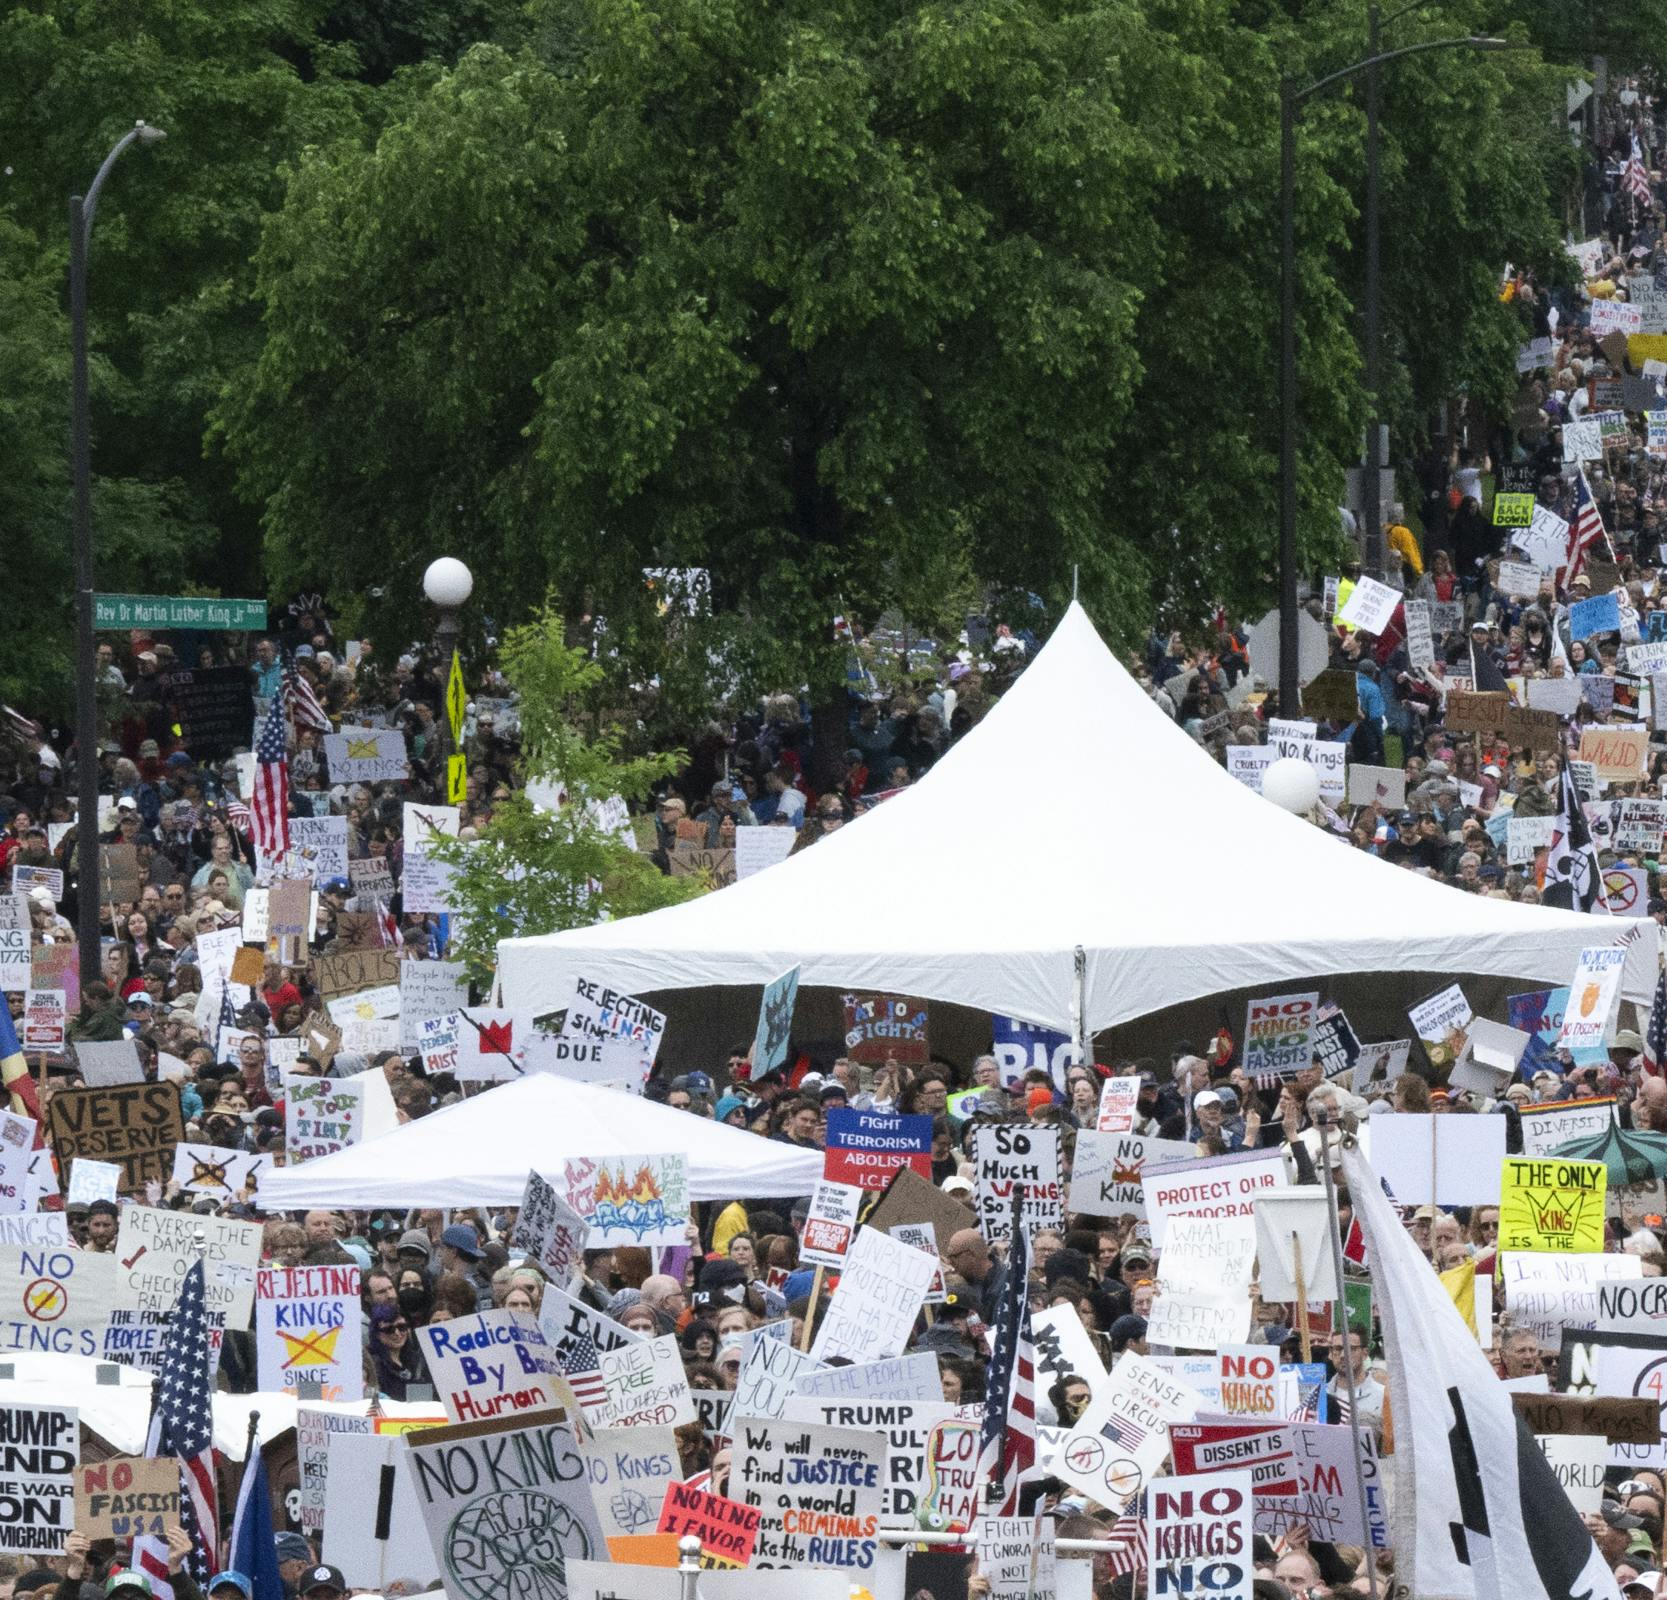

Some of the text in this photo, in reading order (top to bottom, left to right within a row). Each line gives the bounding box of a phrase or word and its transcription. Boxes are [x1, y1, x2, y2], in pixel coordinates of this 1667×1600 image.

[97, 602, 244, 627] Rev Dr Martin Luther King Jr
[57, 1088, 171, 1131] VETS
[57, 1127, 172, 1157] DESERVE
[1511, 1164, 1600, 1189] THE ONLY
[1539, 1209, 1572, 1232] KING
[1510, 1236, 1574, 1248] IS THE
[258, 1268, 361, 1299] REJECTING
[275, 1302, 344, 1328] KINGS
[1602, 1287, 1638, 1320] NO
[746, 1428, 868, 1460] We will never
[83, 1463, 132, 1494] NO
[741, 1458, 879, 1488] find JUSTICE
[92, 1490, 180, 1516] FASCIST
[799, 1490, 856, 1514] world
[1155, 1488, 1244, 1520] NO
[111, 1515, 165, 1537] USA
[783, 1510, 878, 1537] CRIMINALS
[780, 1534, 876, 1568] the RULES
[1155, 1520, 1244, 1561] KINGS
[1155, 1565, 1244, 1594] NO
